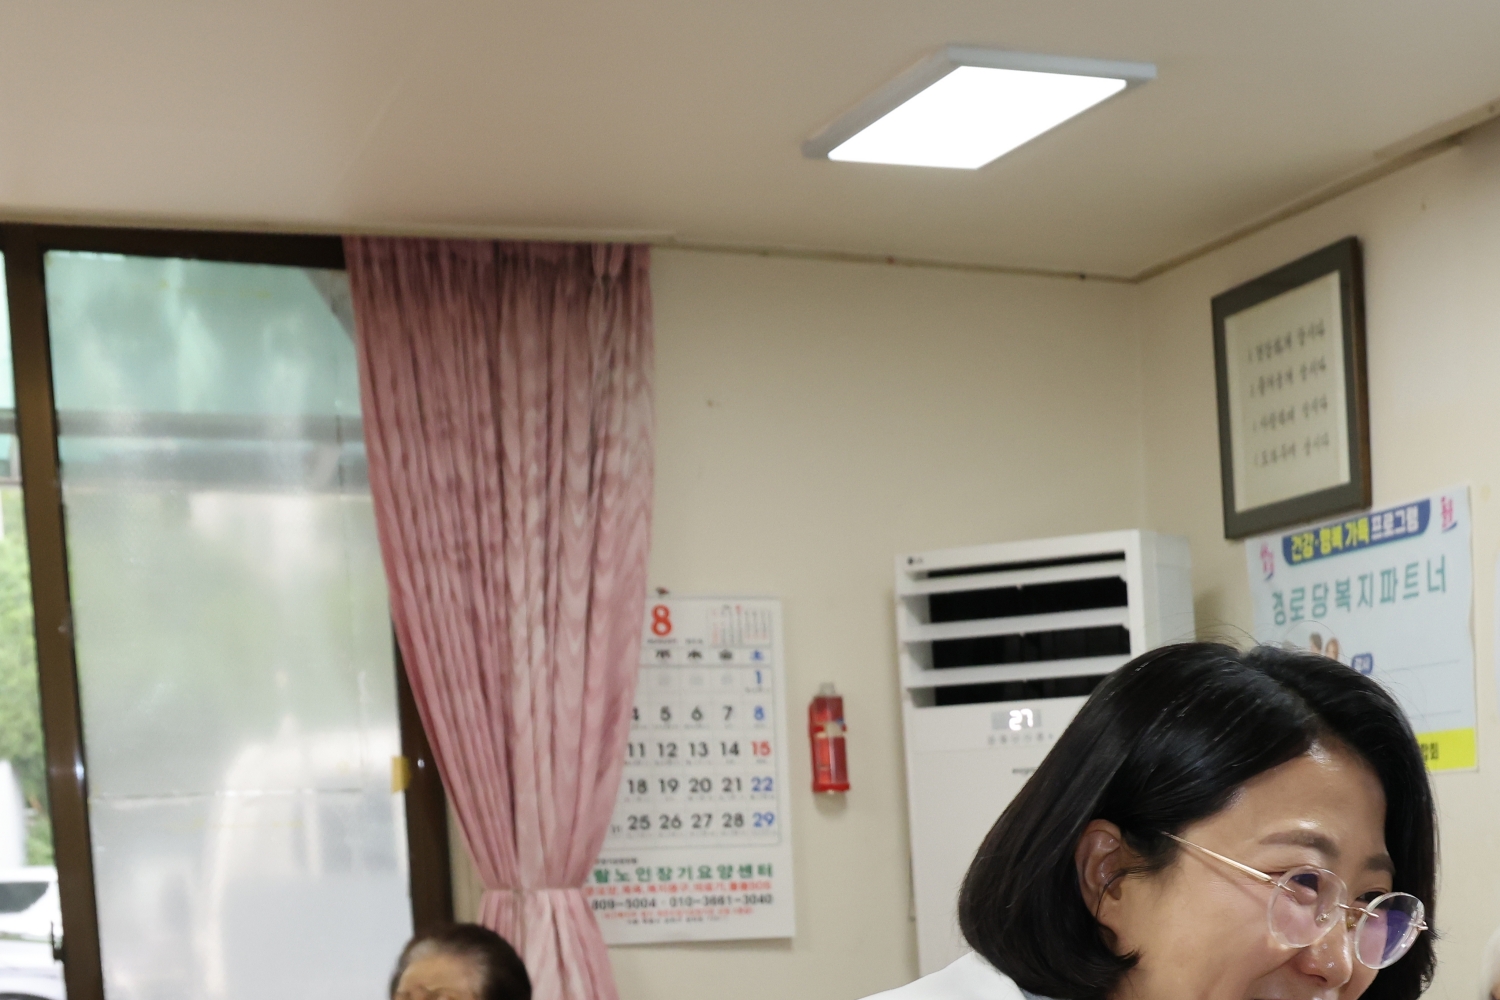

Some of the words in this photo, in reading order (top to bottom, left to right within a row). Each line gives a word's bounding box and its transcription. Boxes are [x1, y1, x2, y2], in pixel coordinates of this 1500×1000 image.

[651, 604, 673, 636] 8
[754, 670, 762, 684] 1
[659, 705, 672, 722] 5
[691, 705, 704, 721] 6
[722, 704, 733, 720] 7
[753, 705, 765, 721] 8
[1009, 708, 1034, 731] 27
[627, 742, 646, 758] 11
[657, 742, 678, 758] 12
[689, 741, 709, 757] 13
[720, 741, 740, 757] 14
[751, 740, 772, 757] 15
[627, 778, 648, 794] 18
[659, 778, 679, 793] 19
[688, 777, 712, 793] 20
[721, 776, 742, 793] 21
[751, 776, 774, 792] 22
[627, 814, 651, 830] 25
[659, 813, 682, 830] 26
[690, 813, 713, 829] 27
[721, 812, 744, 829] 28
[752, 812, 775, 828] 29
